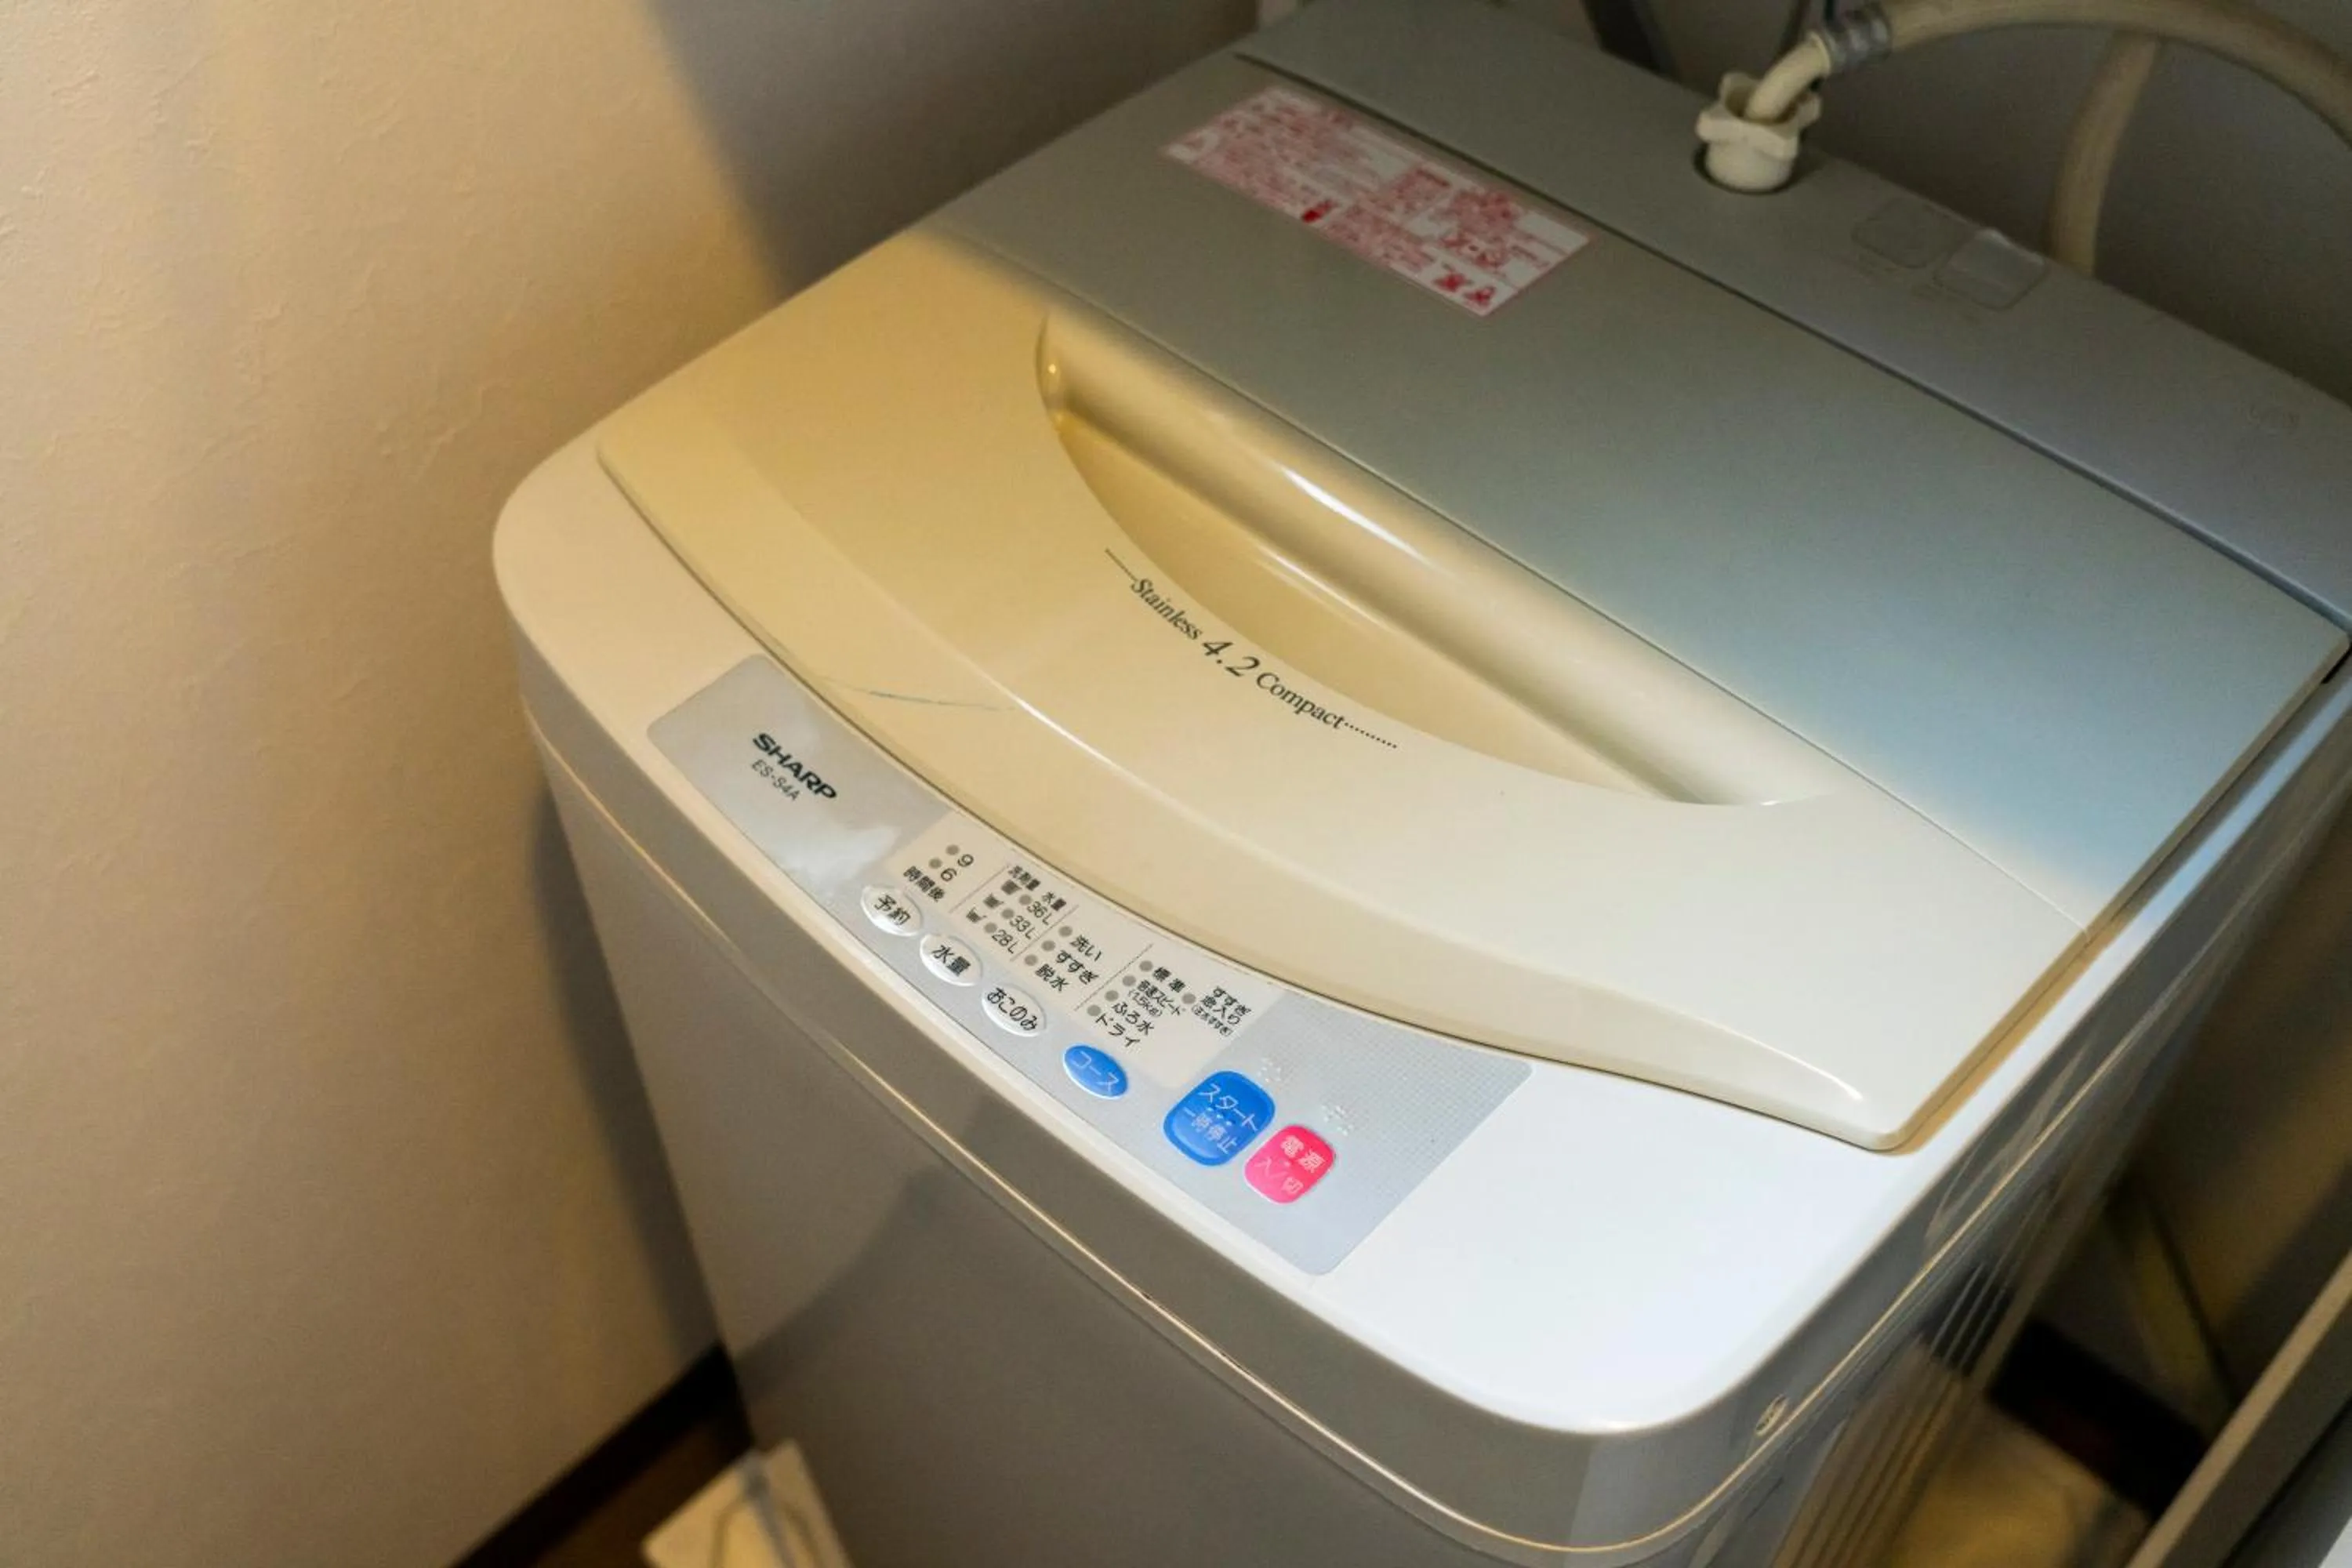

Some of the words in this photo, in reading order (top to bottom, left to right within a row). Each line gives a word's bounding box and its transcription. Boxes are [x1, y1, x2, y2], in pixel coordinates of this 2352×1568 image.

[1131, 578, 1203, 641] Stainless
[1202, 639, 1261, 677] 4.2
[1256, 672, 1345, 730] Compact
[751, 759, 800, 801] ES-S4A
[752, 733, 837, 799] SHARP
[940, 868, 957, 882] 6
[957, 854, 975, 868] 9
[874, 895, 912, 926] 予約
[931, 945, 971, 977] 水量
[1069, 935, 1102, 961] 洗い
[1035, 964, 1069, 993] 脱水
[1055, 949, 1099, 985] すすぎ
[986, 986, 1038, 1031] おこのみ
[1212, 985, 1252, 1017] すすぎ
[1095, 1013, 1141, 1047] ドライ
[1112, 1002, 1155, 1036] ふろ水
[1072, 1051, 1120, 1094] コース
[1198, 1083, 1259, 1131] スタート
[1280, 1134, 1326, 1174] 電源
